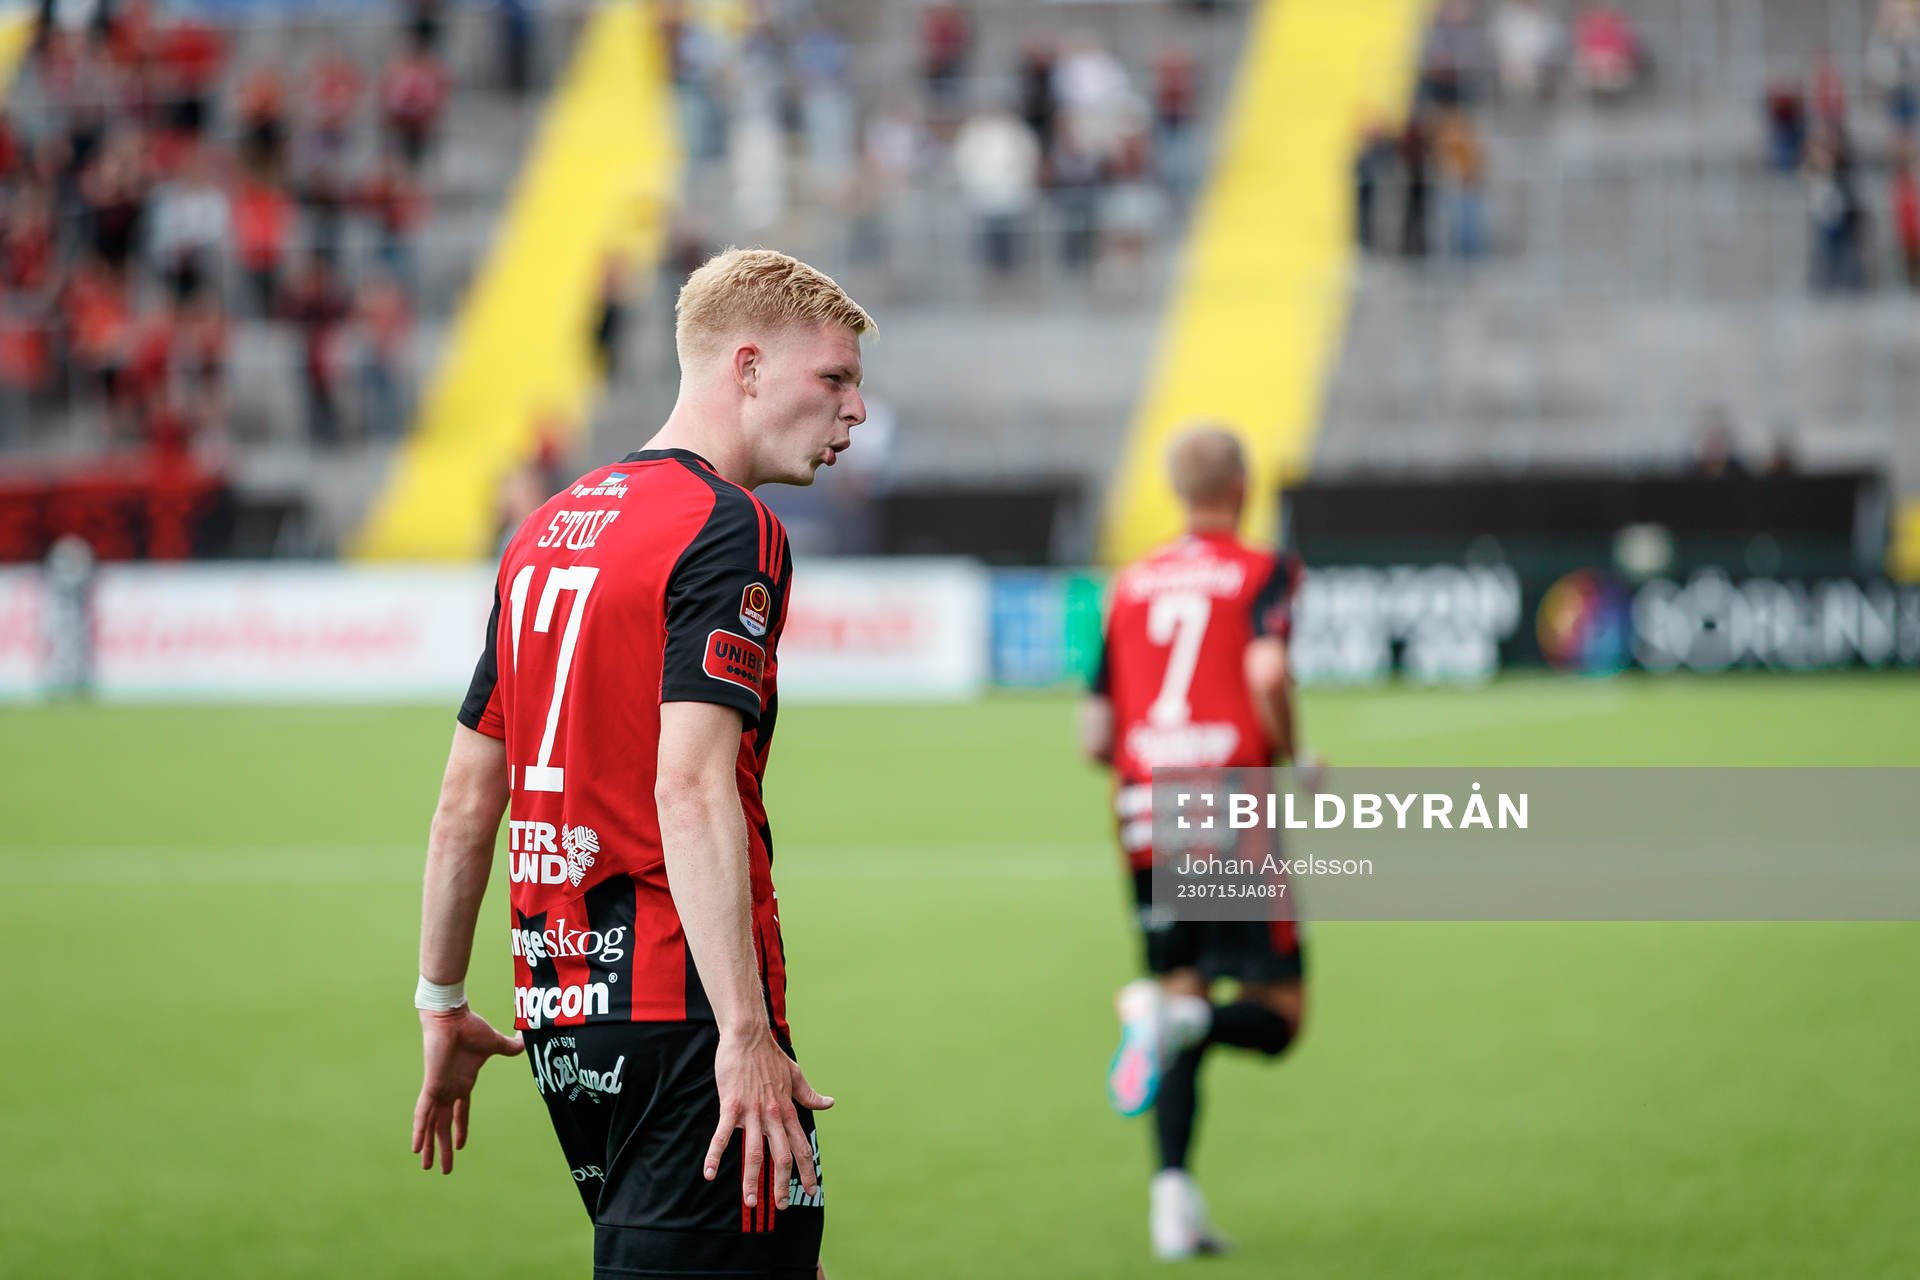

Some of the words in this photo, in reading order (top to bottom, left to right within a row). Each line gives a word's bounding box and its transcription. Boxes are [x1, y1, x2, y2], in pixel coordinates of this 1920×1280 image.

[537, 509, 621, 551] STOLT
[508, 564, 600, 793] 17
[1147, 588, 1213, 729] 7
